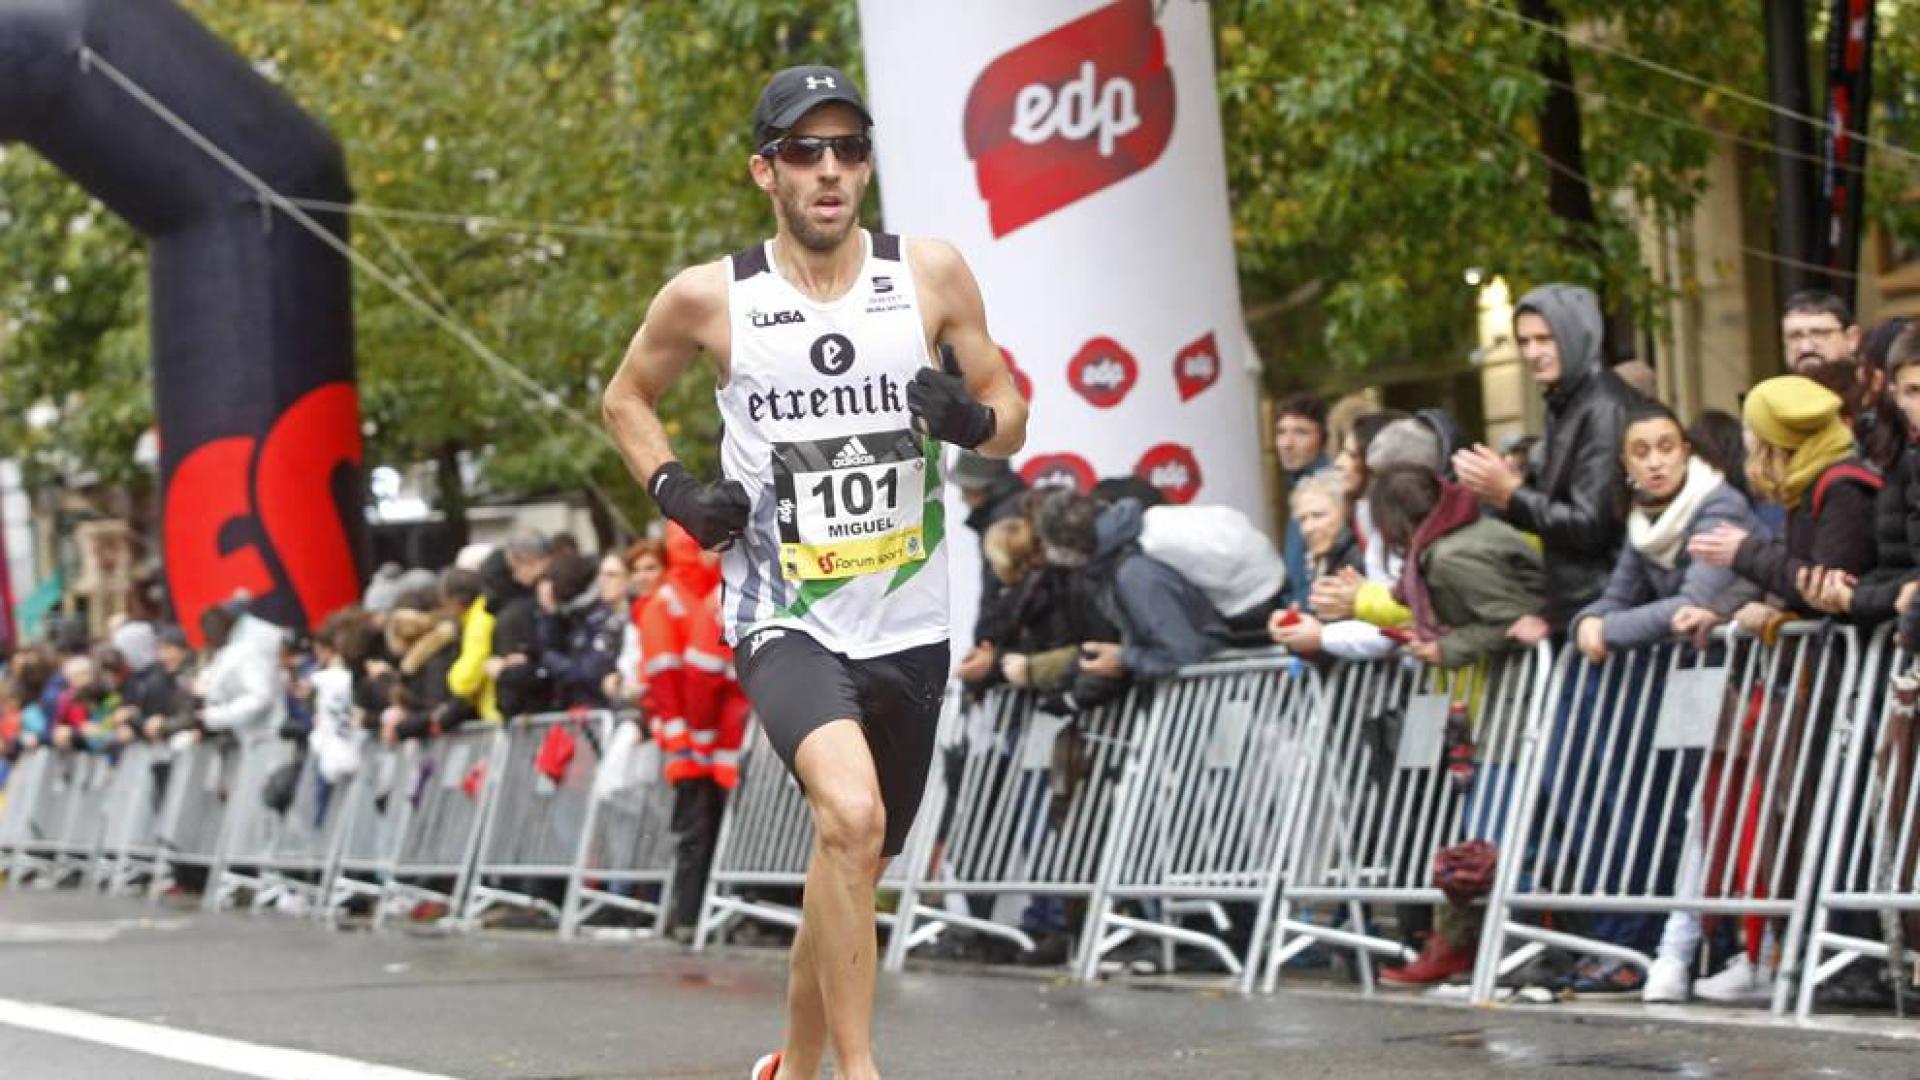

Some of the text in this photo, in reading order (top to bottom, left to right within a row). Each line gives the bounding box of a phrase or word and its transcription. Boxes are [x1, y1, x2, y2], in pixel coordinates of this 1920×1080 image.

[1010, 62, 1142, 157] edp
[1081, 358, 1126, 389] edp
[748, 372, 904, 422] etxenik
[832, 454, 876, 468] adidas
[1150, 461, 1190, 491] edp
[812, 467, 898, 518] 101
[828, 517, 895, 537] MIGUEL
